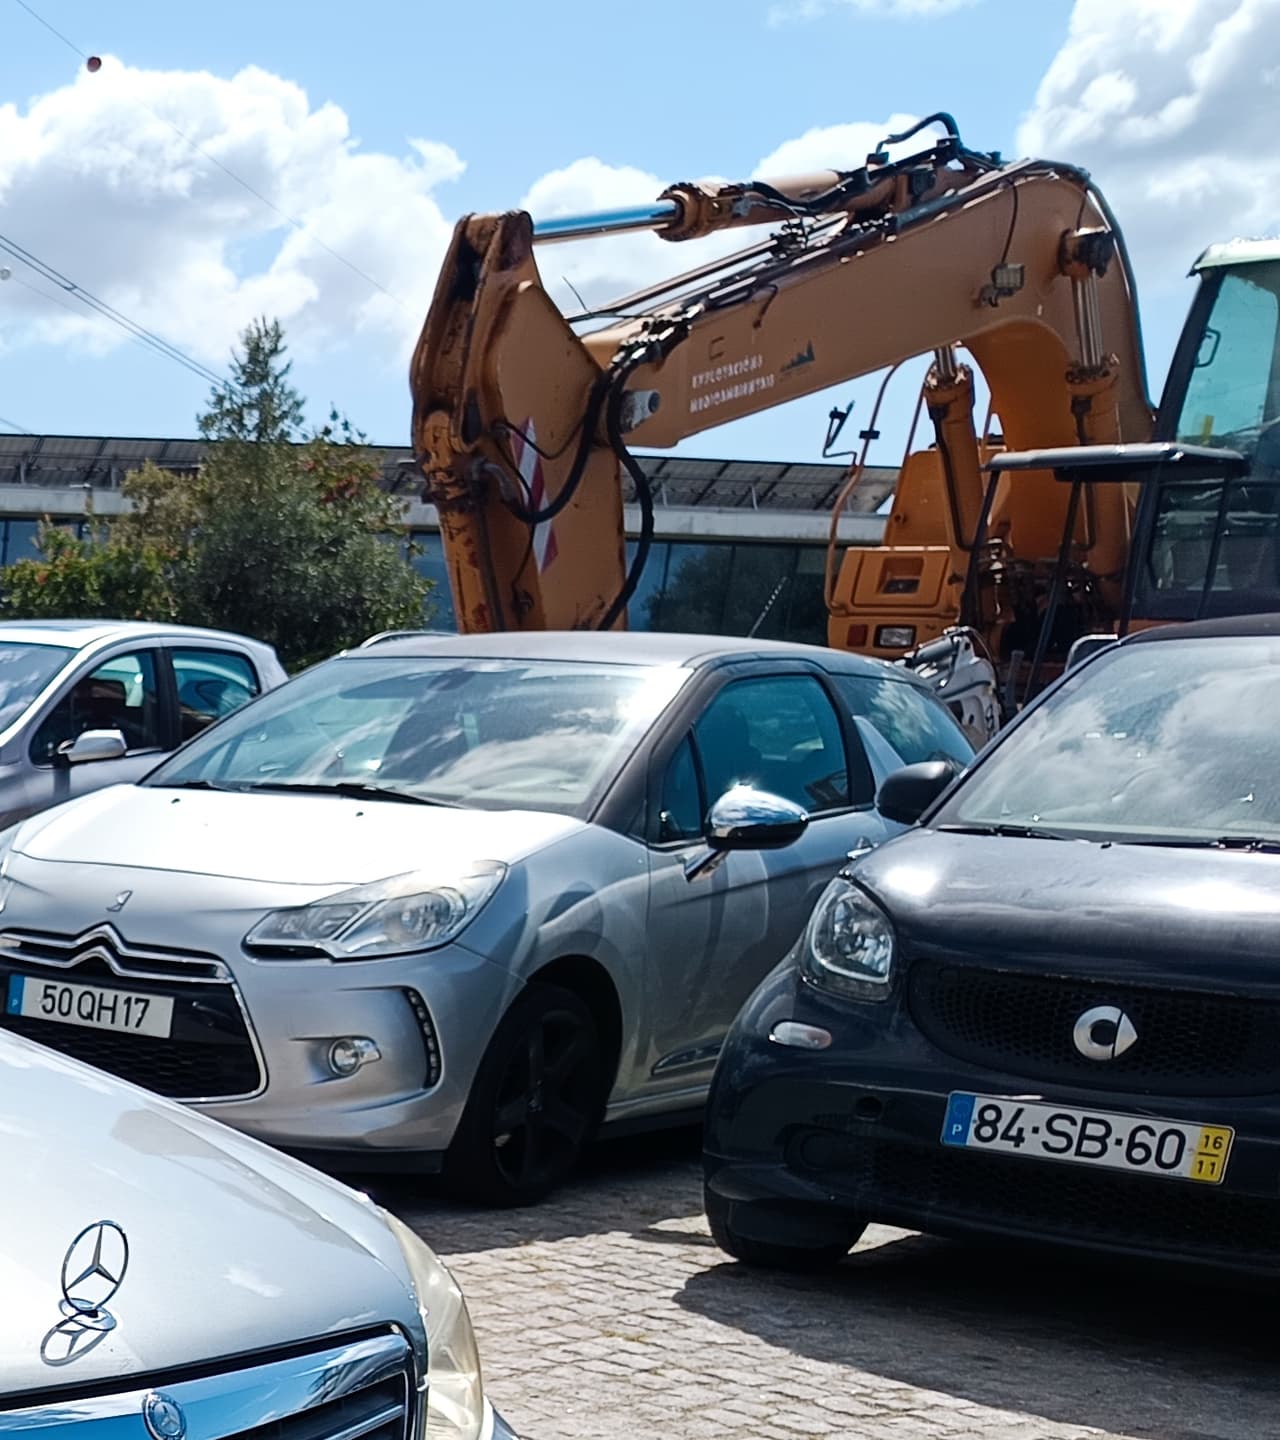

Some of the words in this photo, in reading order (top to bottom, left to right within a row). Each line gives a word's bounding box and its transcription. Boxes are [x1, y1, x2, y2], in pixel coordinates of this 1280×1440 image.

[951, 1124, 963, 1136] P
[1202, 1134, 1224, 1151] 16
[1197, 1159, 1217, 1177] 11
